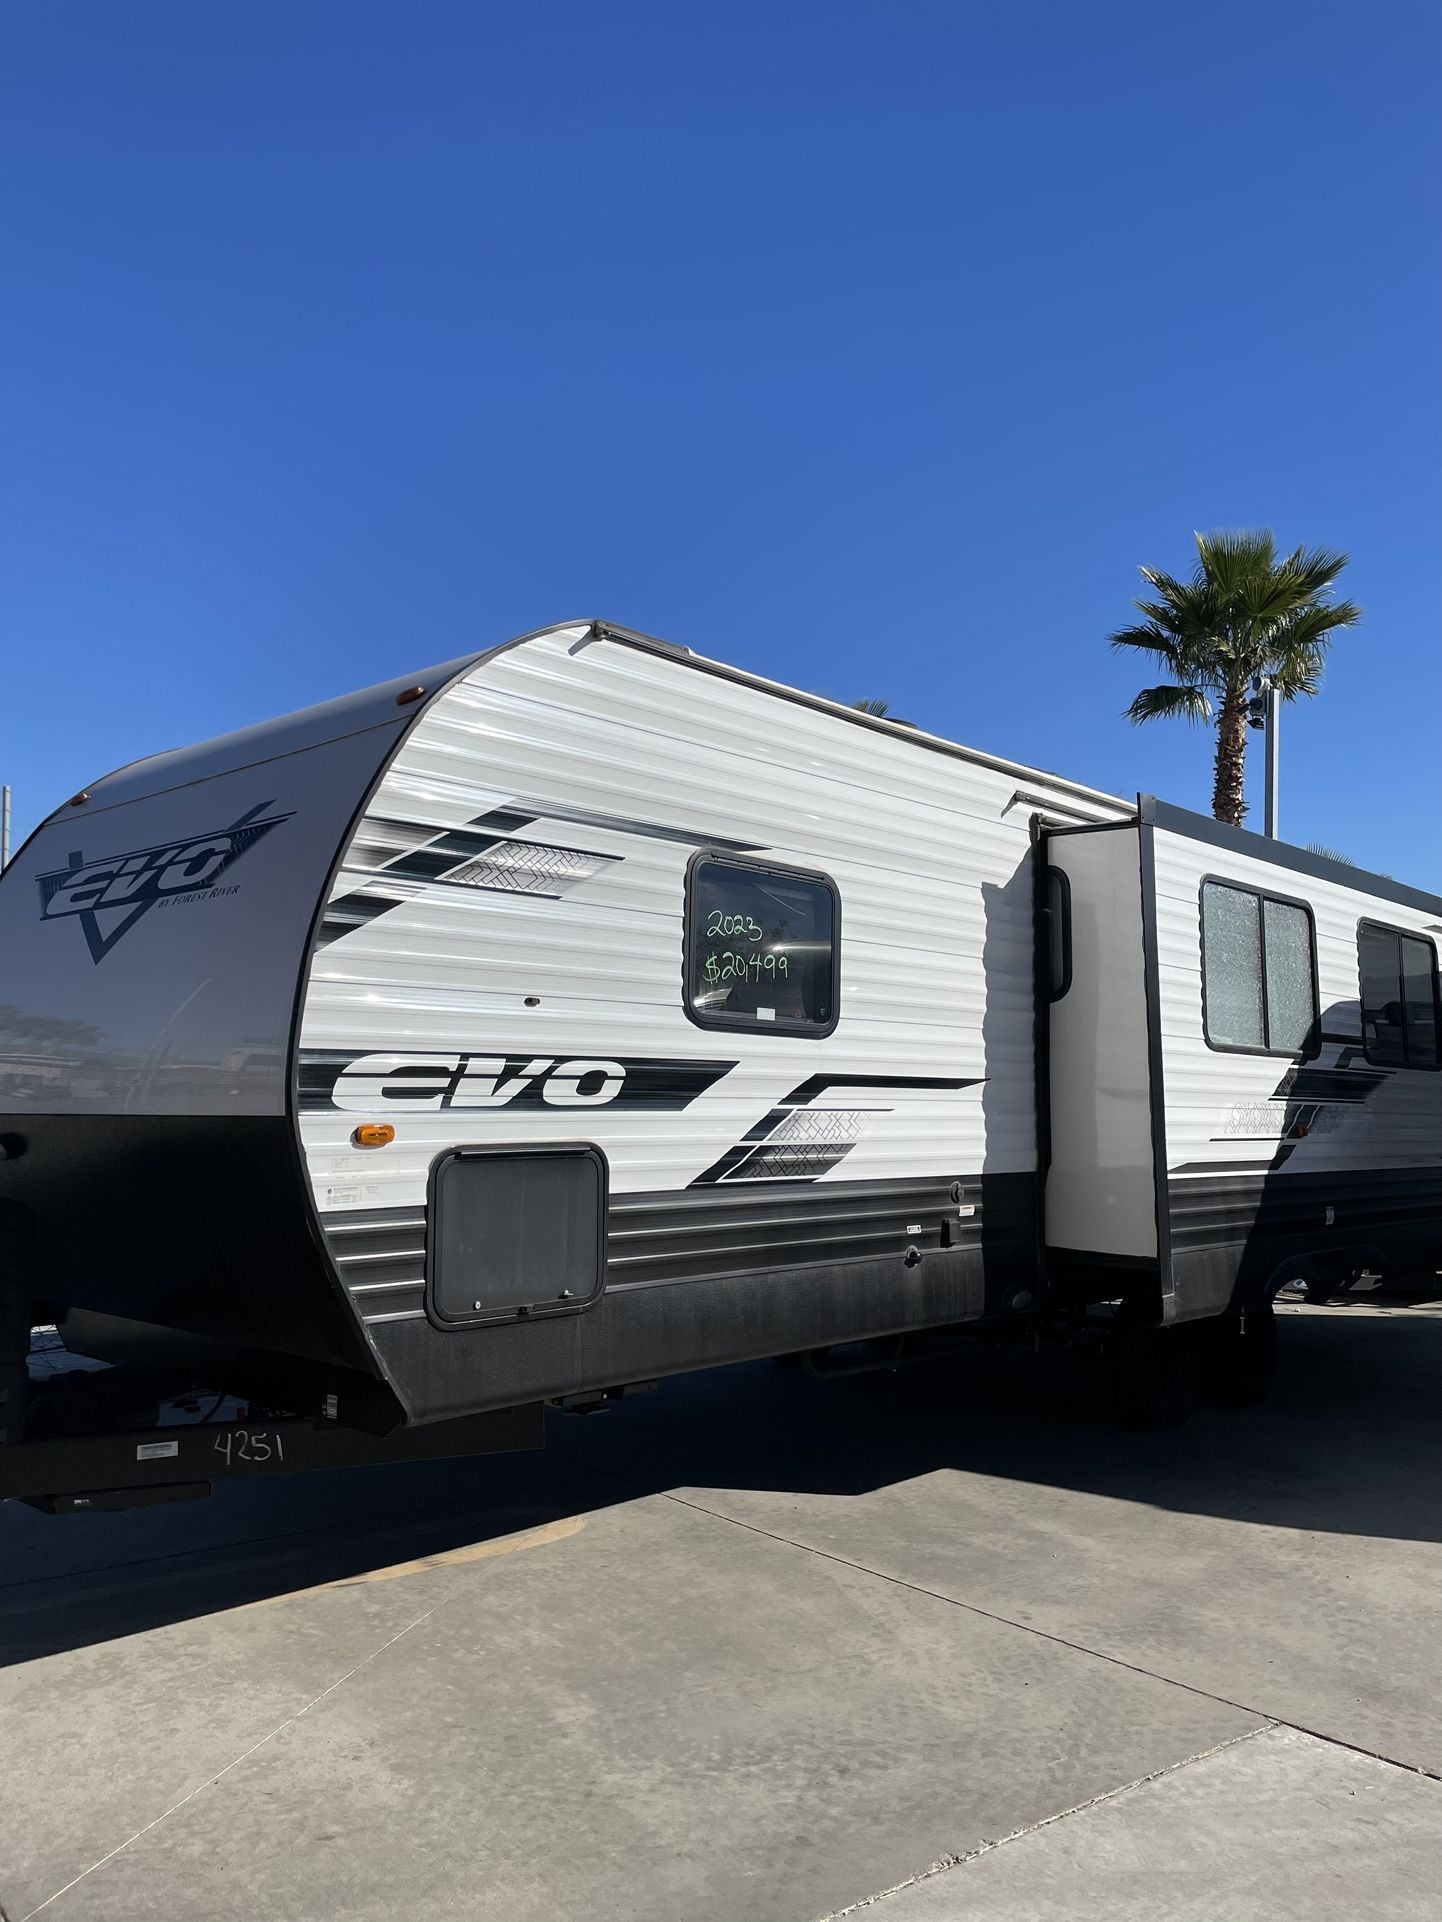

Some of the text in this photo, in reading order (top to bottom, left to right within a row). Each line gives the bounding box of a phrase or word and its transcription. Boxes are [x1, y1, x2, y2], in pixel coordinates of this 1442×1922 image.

[46, 837, 232, 914] EVO
[158, 885, 241, 908] BY FOREST RIVER
[706, 910, 762, 941] 2023
[703, 952, 788, 984] $20,499
[331, 1053, 626, 1111] EVO
[213, 1430, 283, 1465] 4251
